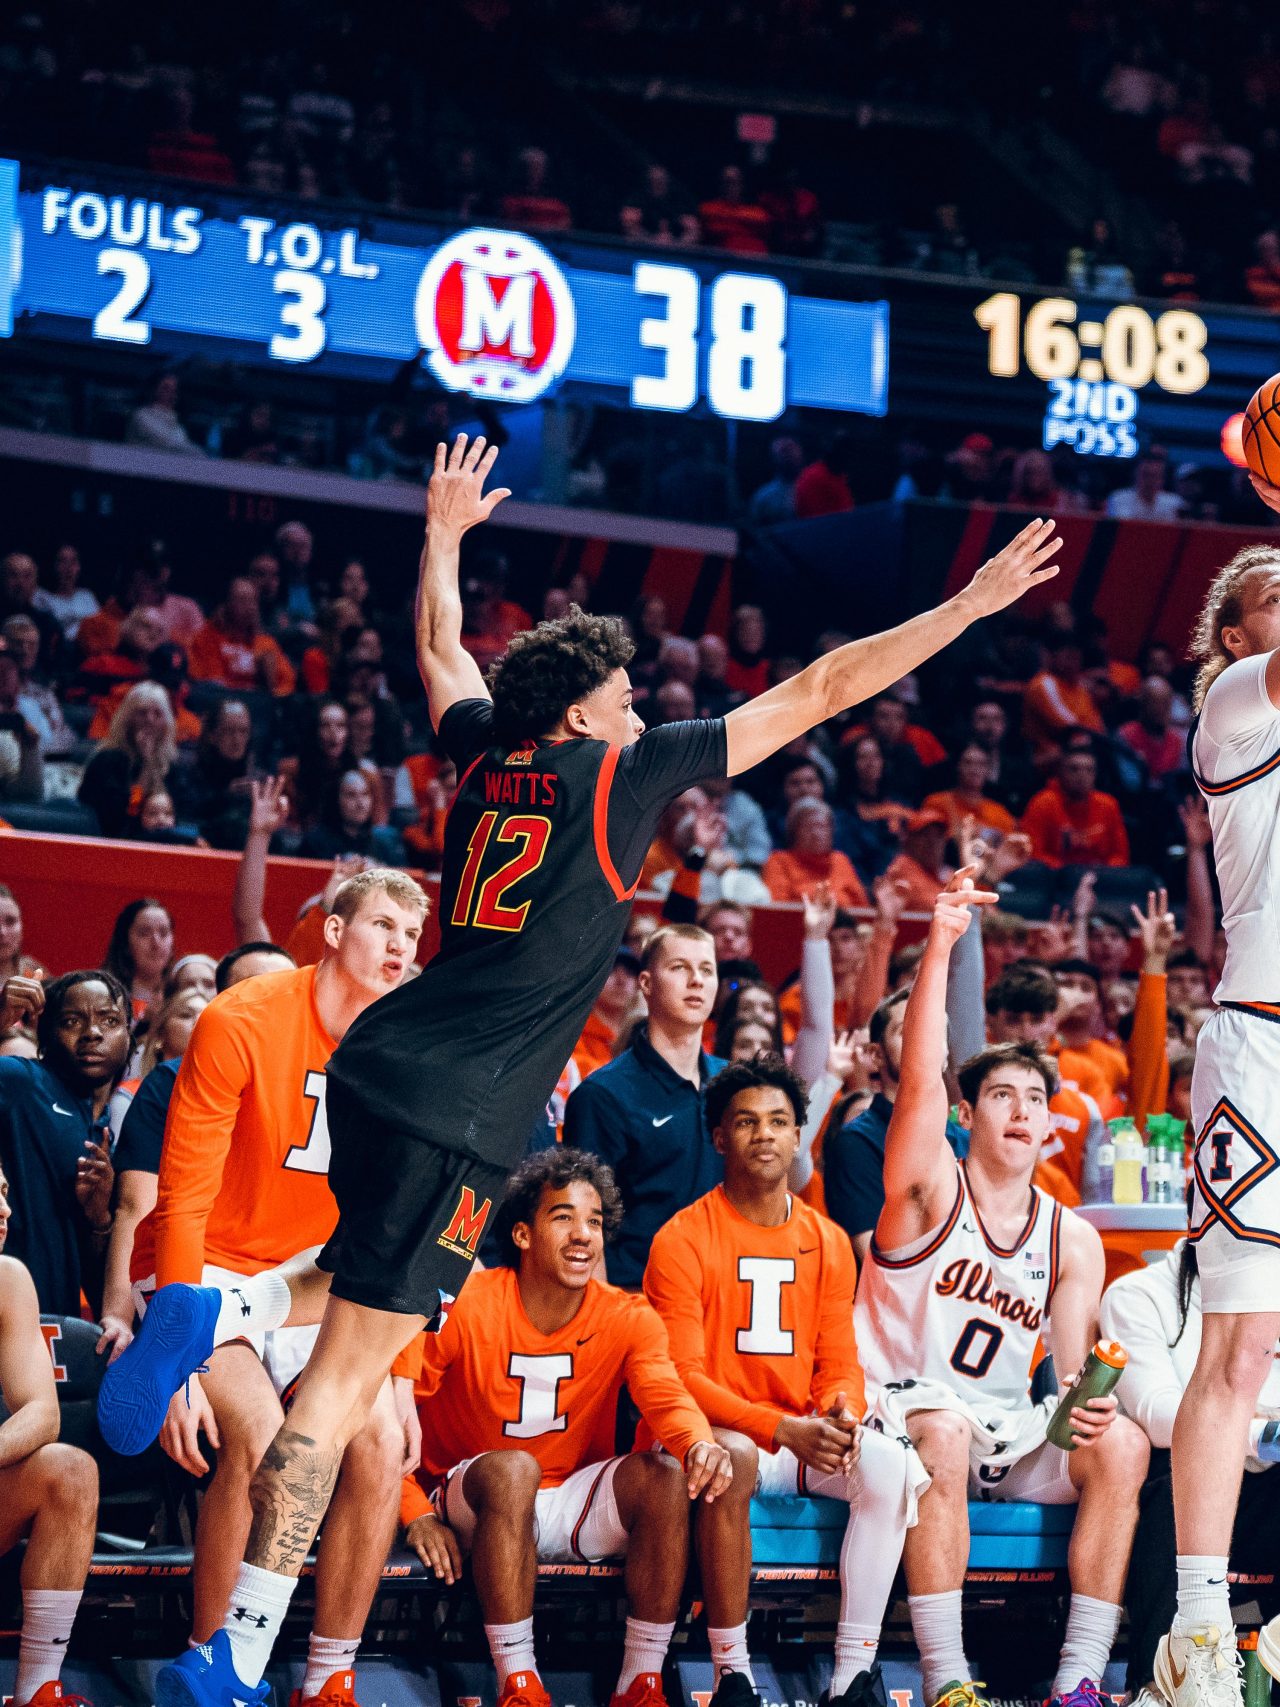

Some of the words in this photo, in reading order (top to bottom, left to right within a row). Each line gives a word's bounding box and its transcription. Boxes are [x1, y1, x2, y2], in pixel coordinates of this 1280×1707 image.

[42, 186, 203, 255] FOULS
[239, 216, 380, 279] T.O.L.
[93, 249, 151, 344] 2
[268, 270, 327, 362] 3
[457, 264, 536, 358] M
[630, 261, 788, 422] 38
[974, 292, 1209, 395] 16:08
[1042, 416, 1139, 459] POSS
[1047, 378, 1139, 421] 2ND
[484, 771, 558, 805] WATTS
[451, 811, 552, 932] 12
[1209, 1131, 1233, 1184] I
[440, 1186, 493, 1253] M
[736, 1256, 796, 1356] I
[950, 1317, 1005, 1379] 0
[502, 1353, 574, 1439] I
